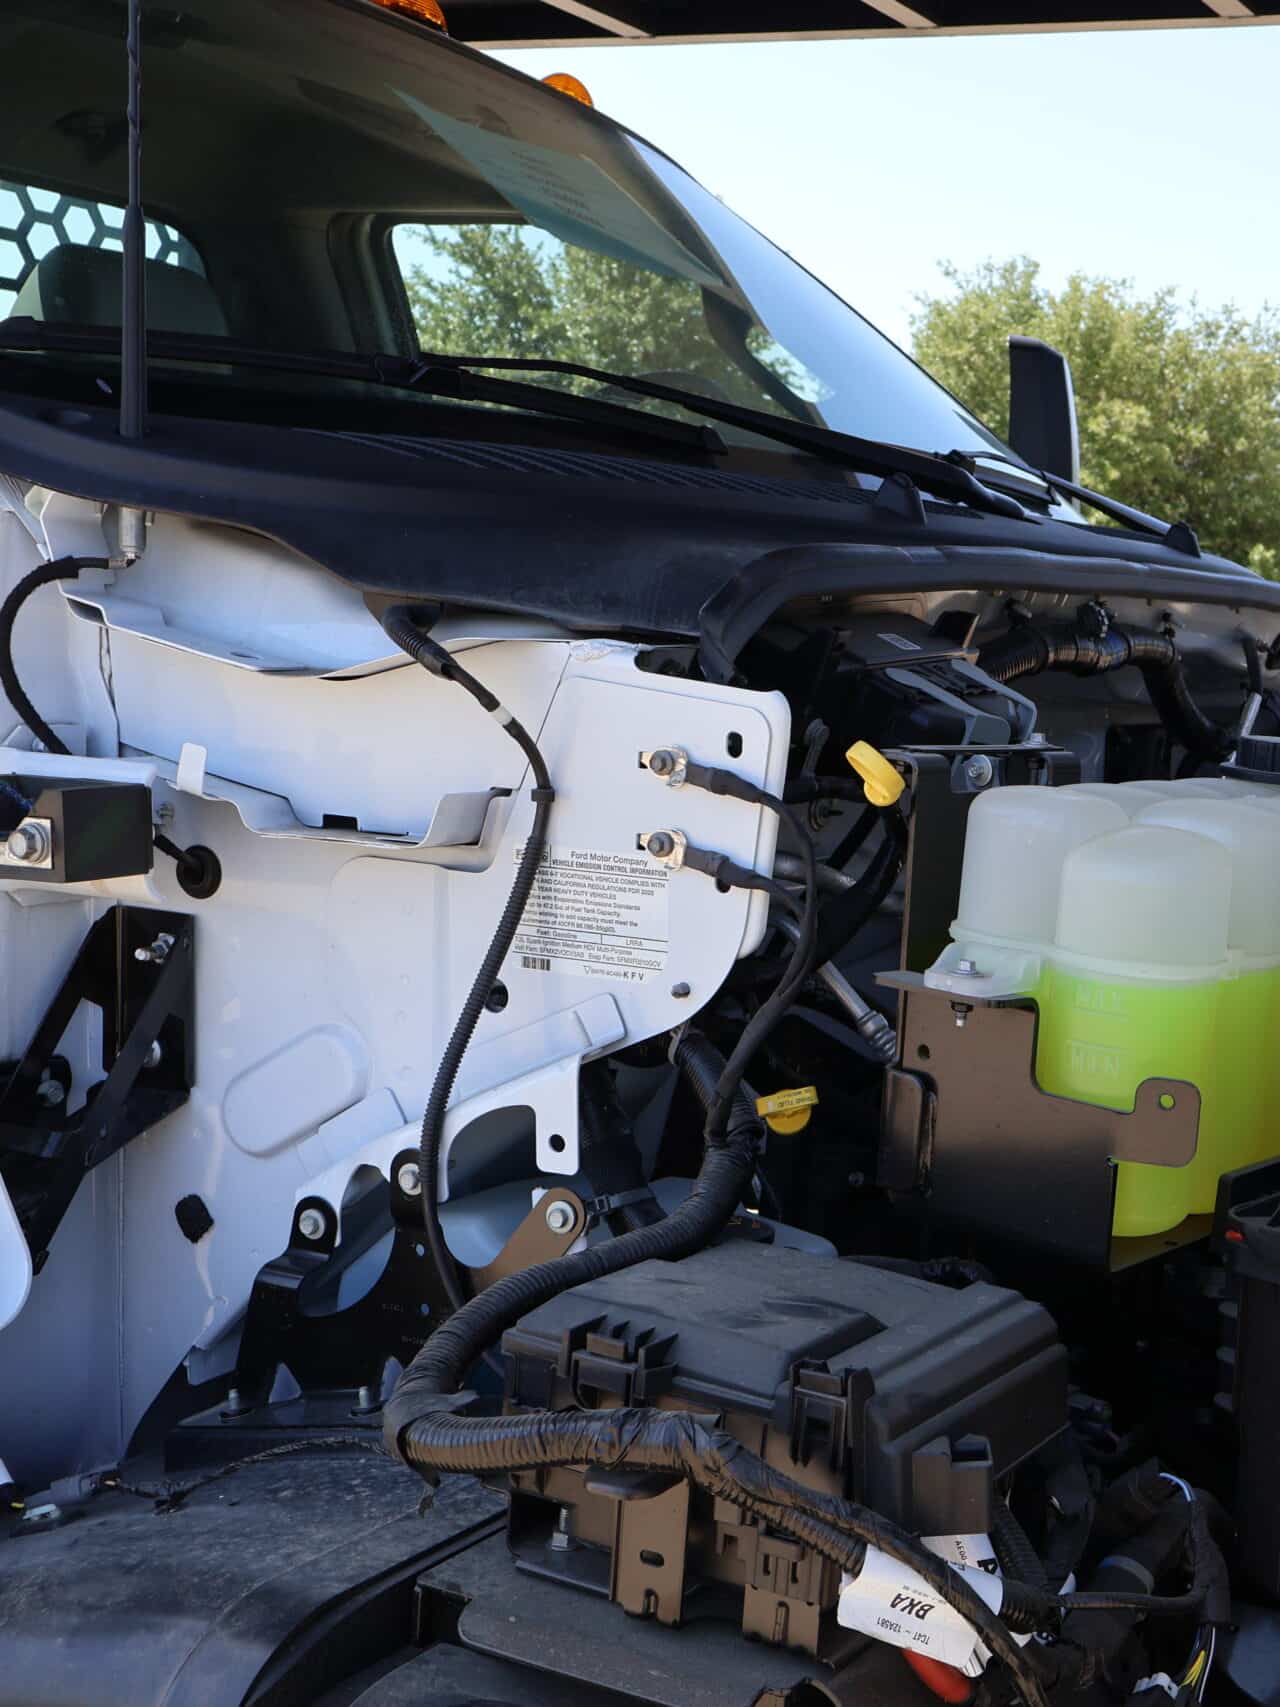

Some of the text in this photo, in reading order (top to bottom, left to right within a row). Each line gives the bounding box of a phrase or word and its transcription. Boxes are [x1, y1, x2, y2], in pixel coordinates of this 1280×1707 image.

[570, 851, 648, 867] Ford Motor Company
[552, 859, 668, 877] VEHICLE EMISSION CONTROL INFORMATION
[553, 879, 586, 888] CALIFORNIA
[587, 883, 626, 893] REGULATIONS
[560, 872, 594, 882] VOCATIONAL
[595, 876, 619, 884] VEHICLE
[620, 879, 650, 888] COMPLIES
[590, 892, 616, 900] VEHICLES
[536, 928, 551, 936] Fuel:
[630, 920, 638, 928] the
[889, 1592, 935, 1620] BKA
[912, 1630, 931, 1646] TC4T
